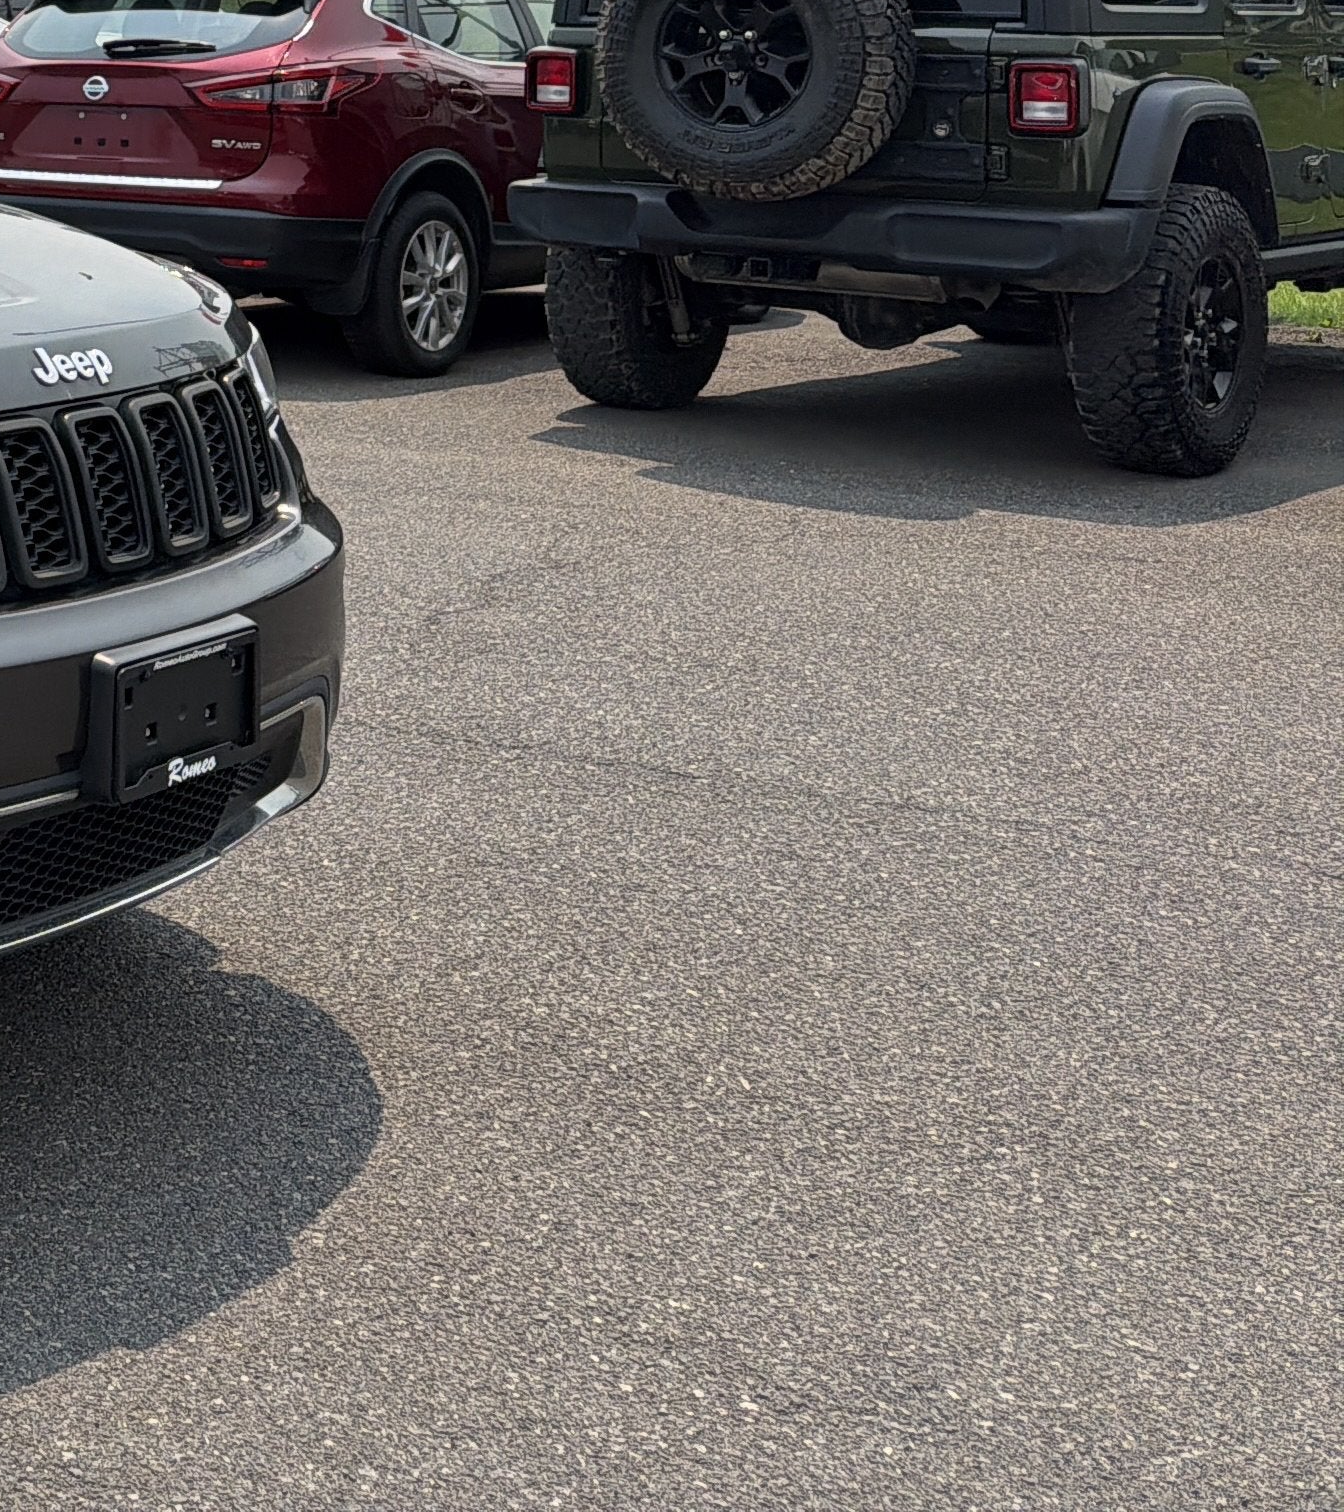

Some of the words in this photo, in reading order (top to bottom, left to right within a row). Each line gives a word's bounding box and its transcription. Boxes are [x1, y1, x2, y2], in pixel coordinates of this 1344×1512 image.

[211, 139, 236, 149] SV
[235, 142, 262, 150] AWD
[32, 347, 113, 387] Jeep
[168, 755, 217, 787] Romeo
